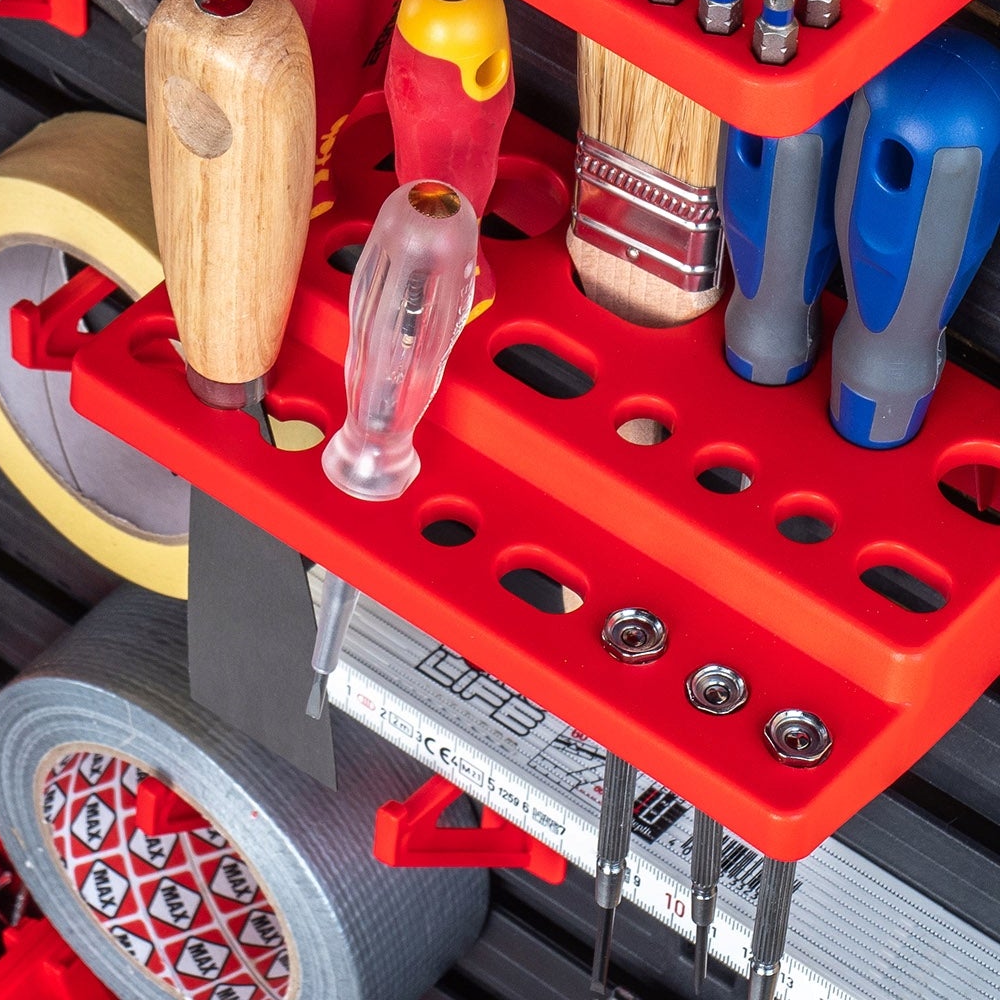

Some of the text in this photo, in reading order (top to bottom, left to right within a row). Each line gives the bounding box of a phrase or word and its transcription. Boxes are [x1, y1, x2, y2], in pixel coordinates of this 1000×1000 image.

[86, 801, 102, 842] MAX
[93, 868, 118, 909] MAX
[222, 862, 252, 899] MAX
[487, 777, 496, 791] 5
[499, 787, 520, 807] 1259
[522, 801, 530, 814] 6
[665, 892, 686, 918] 10
[780, 972, 794, 988] 13
[160, 885, 190, 923] MAX
[250, 914, 281, 945] MAX
[187, 942, 219, 977] MAX
